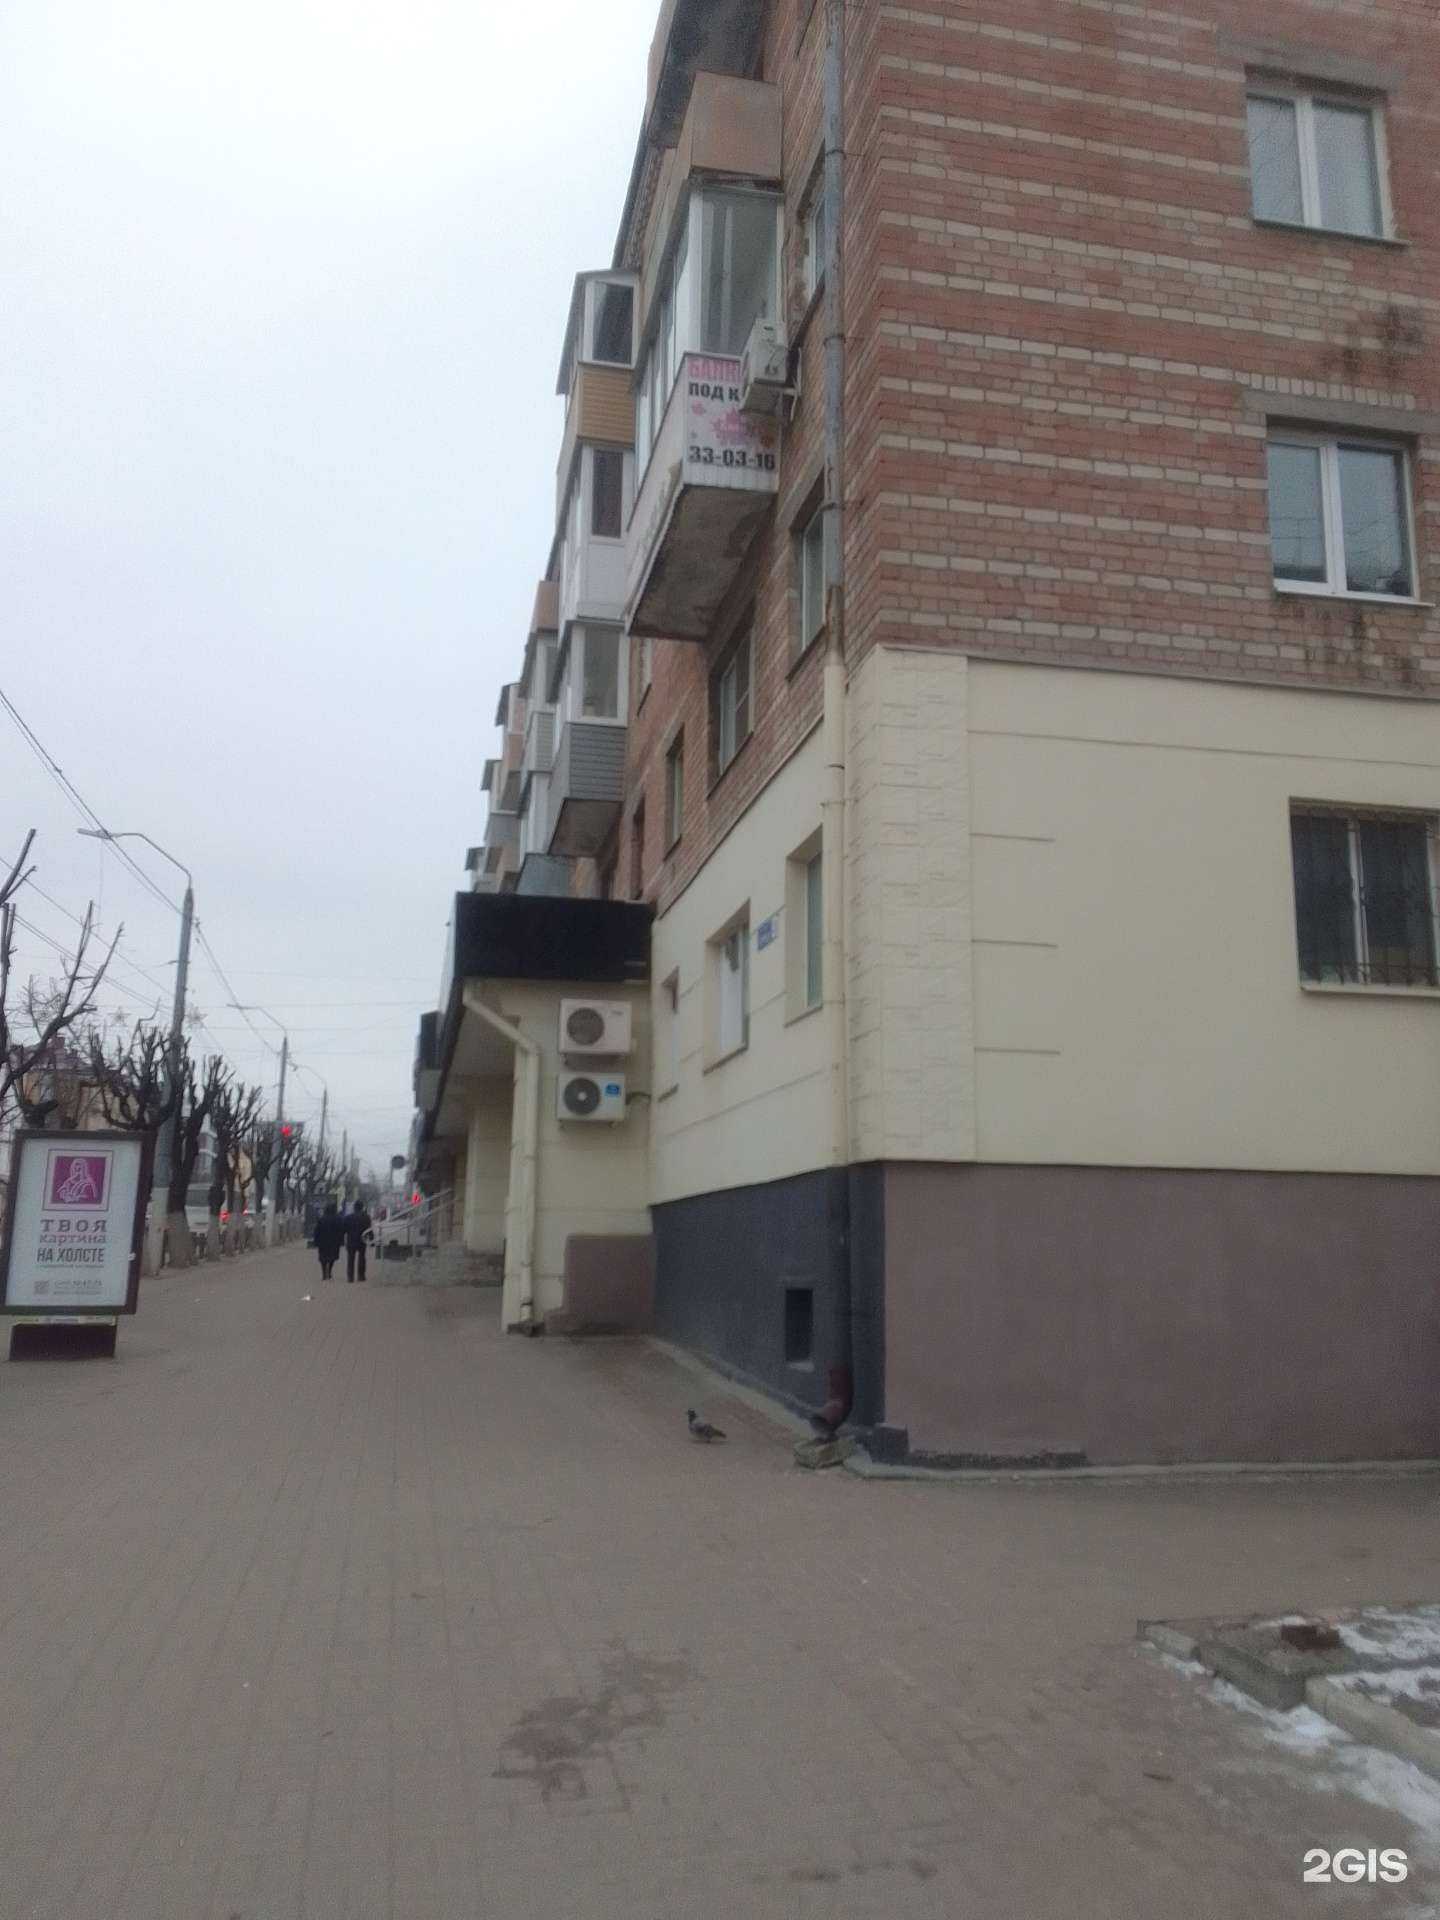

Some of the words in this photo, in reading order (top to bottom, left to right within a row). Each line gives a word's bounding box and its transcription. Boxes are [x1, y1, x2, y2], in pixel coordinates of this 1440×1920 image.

[40, 1219, 107, 1233] ТВОЯ
[39, 1234, 107, 1247] картина
[36, 1247, 53, 1263] НА
[56, 1247, 105, 1263] ХОЛСТЕ
